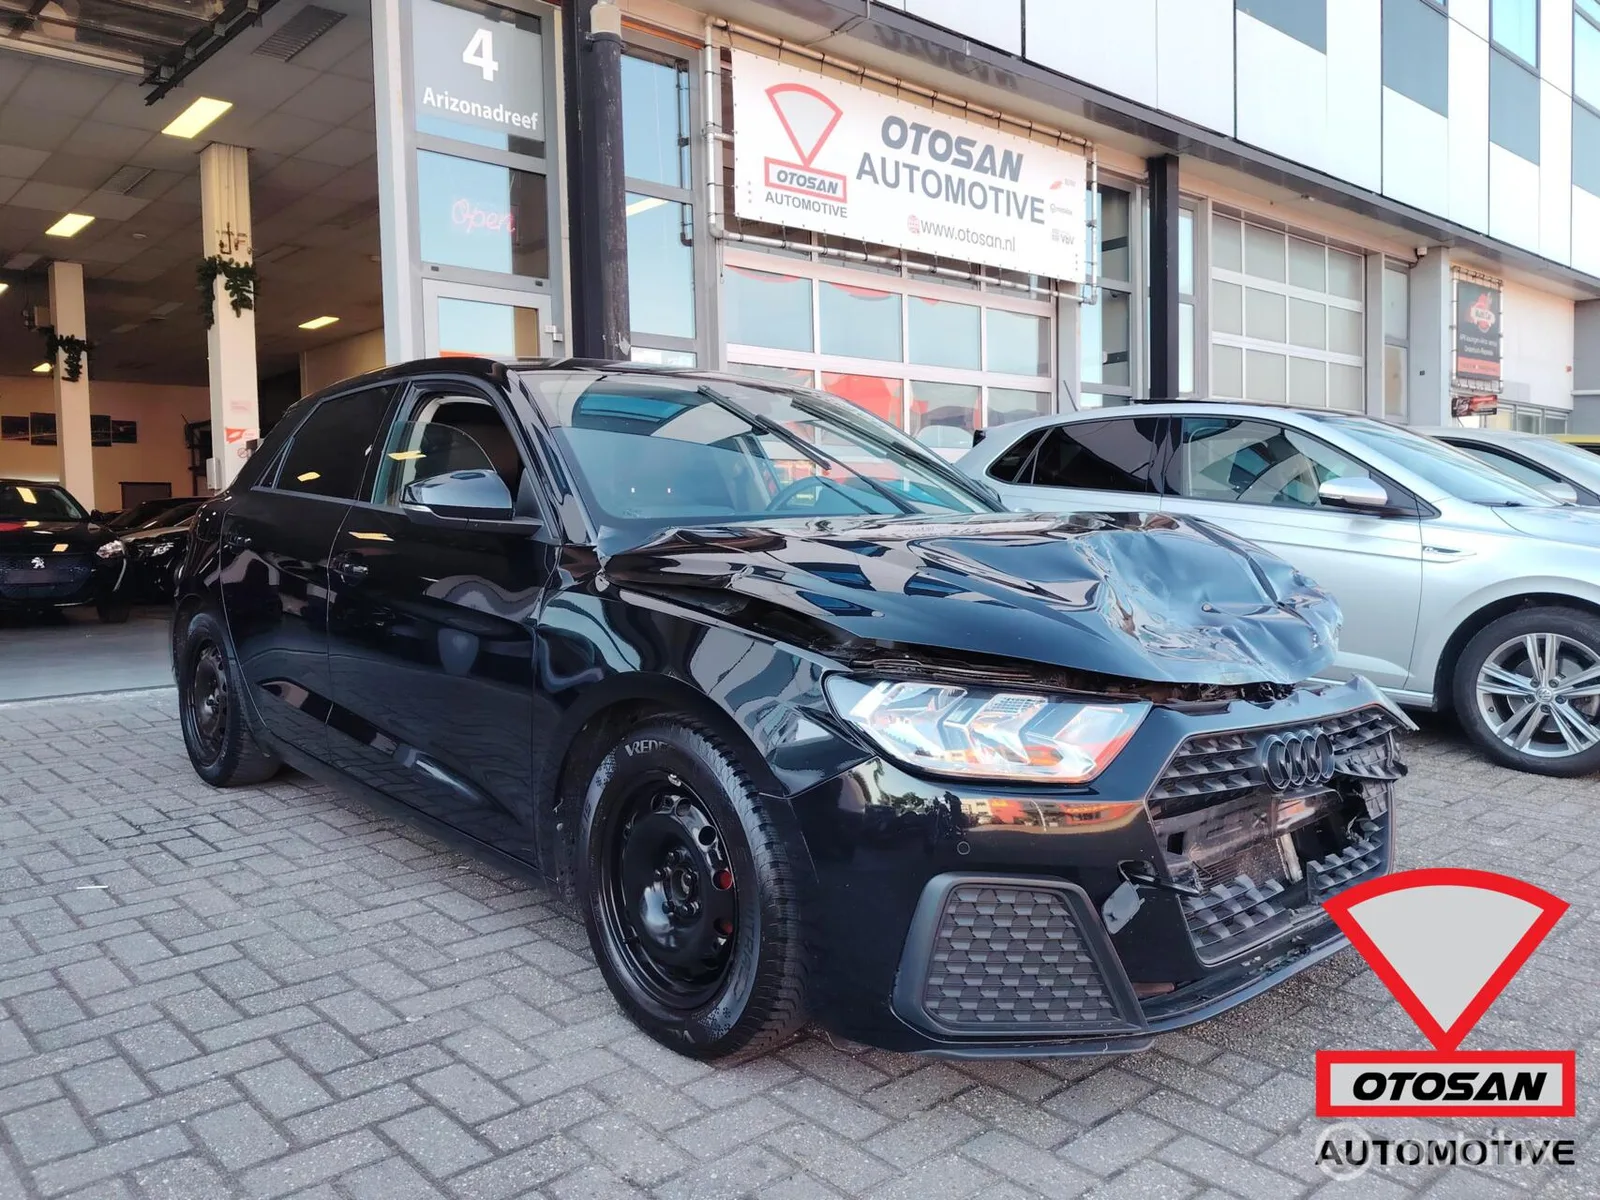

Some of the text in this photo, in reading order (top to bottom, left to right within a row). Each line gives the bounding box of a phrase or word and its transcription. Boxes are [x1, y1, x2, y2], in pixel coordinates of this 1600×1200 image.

[462, 28, 499, 82] 4
[422, 87, 539, 131] Arizonadreef
[881, 115, 1024, 183] OTOSAN
[776, 170, 839, 195] OTOSAN
[856, 151, 1046, 225] AUTOMOTIVE
[451, 198, 516, 234] Open
[765, 191, 848, 219] AUTOMOTIVE
[920, 219, 1016, 253] www.otosan.nl
